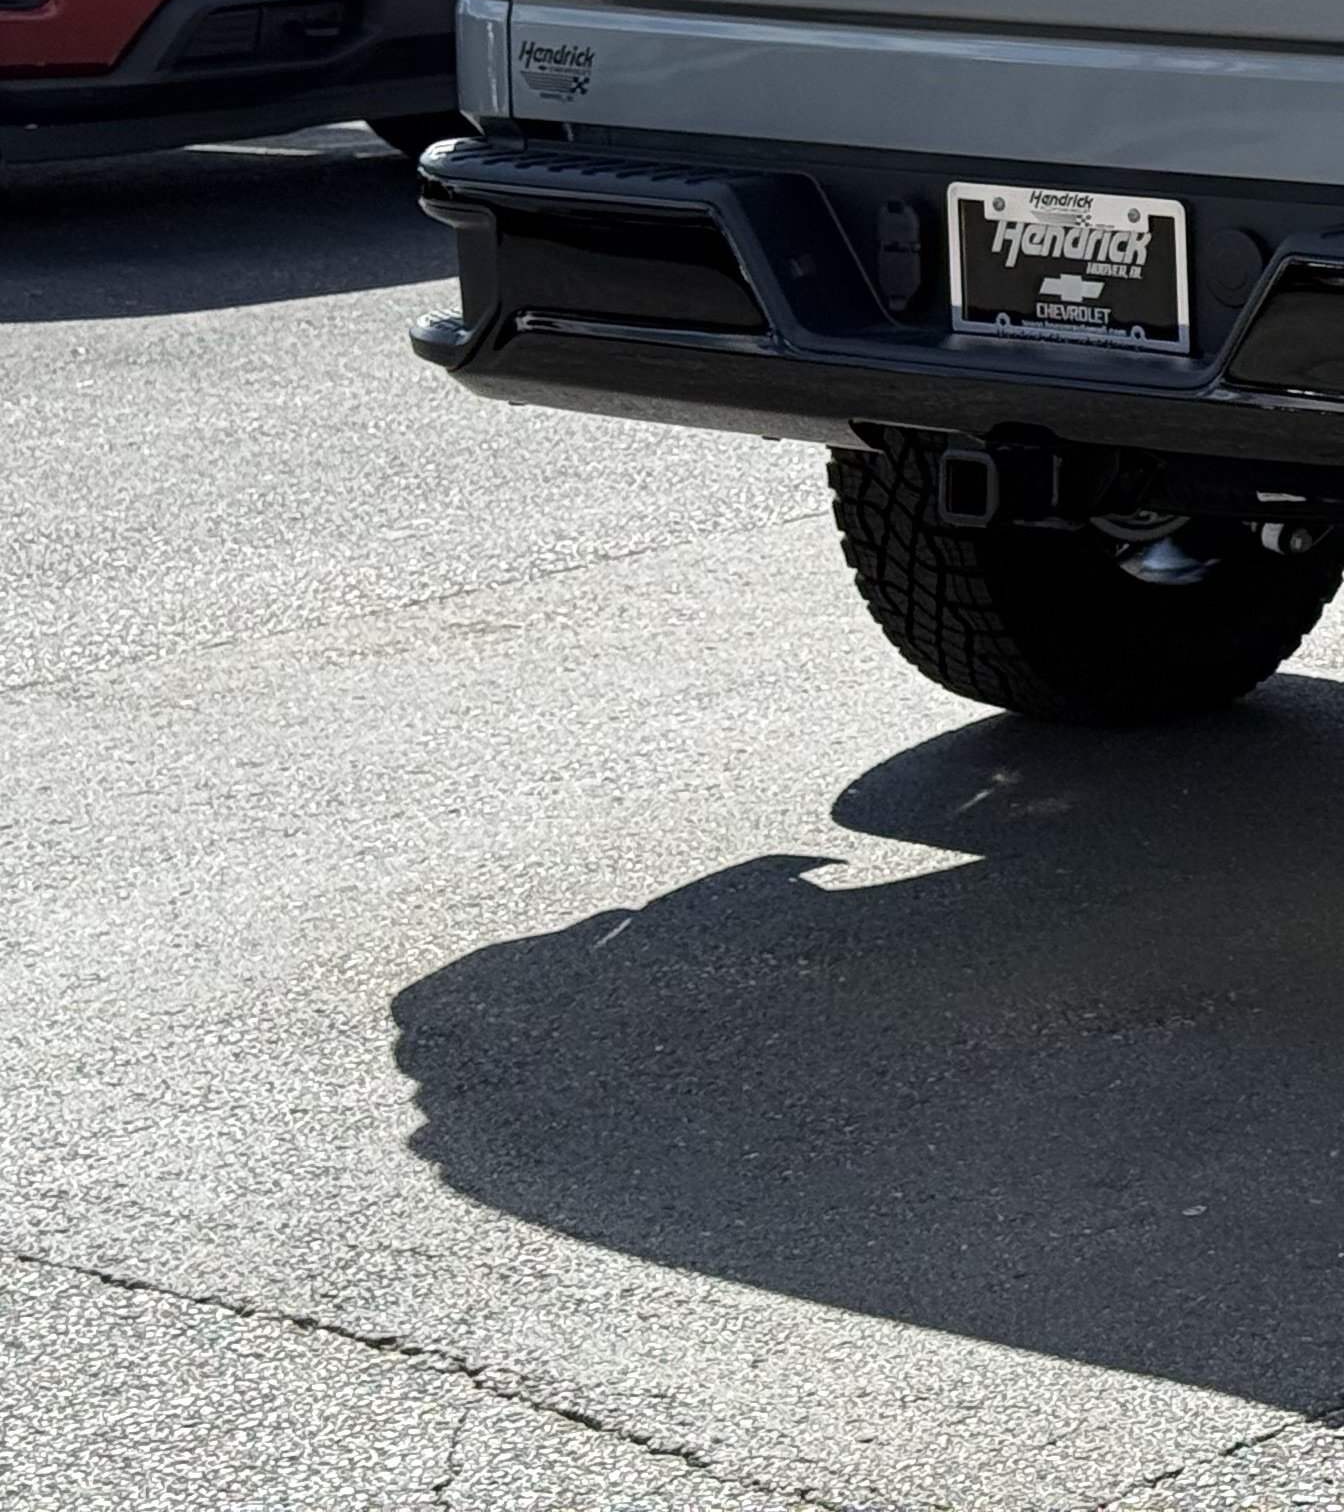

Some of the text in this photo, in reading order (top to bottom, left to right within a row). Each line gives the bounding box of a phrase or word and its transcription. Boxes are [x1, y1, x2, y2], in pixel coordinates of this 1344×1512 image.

[518, 40, 595, 69] Hendrick
[1029, 190, 1094, 210] Hendrick
[991, 220, 1152, 268] Hendrick
[1035, 301, 1112, 325] CHEVROLET
